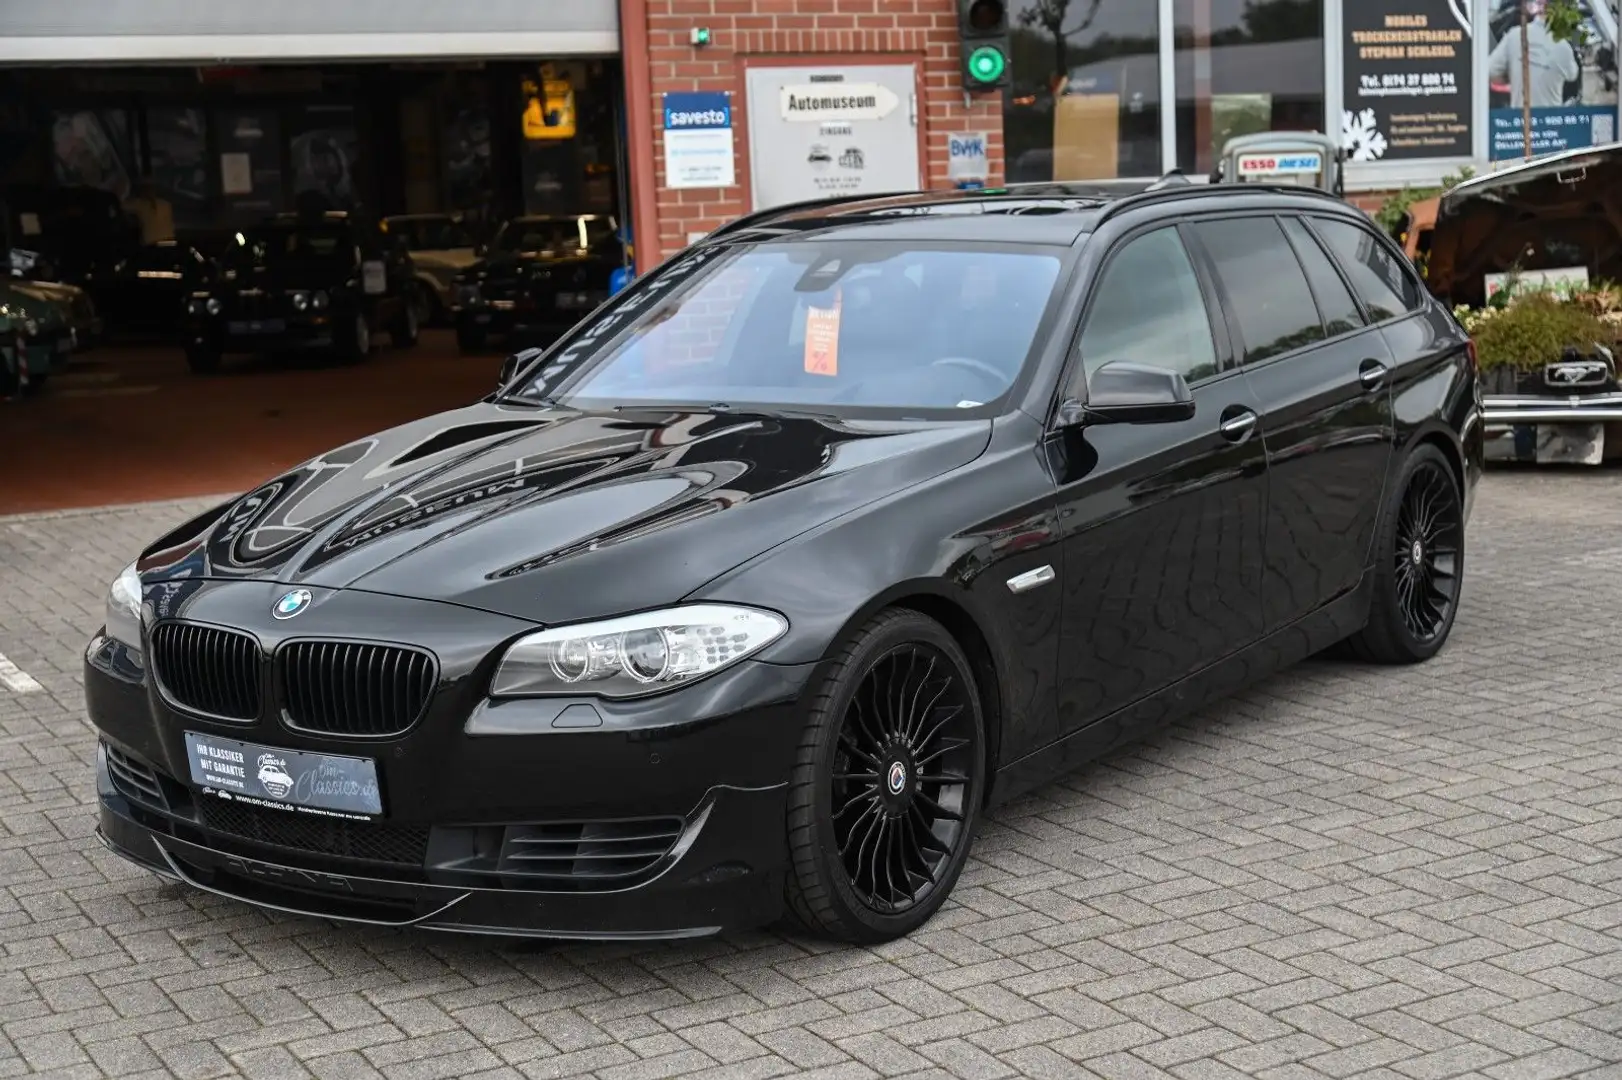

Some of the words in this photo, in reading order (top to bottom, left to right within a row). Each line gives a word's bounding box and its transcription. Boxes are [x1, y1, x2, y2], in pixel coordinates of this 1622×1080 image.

[788, 94, 876, 111] Automuseum
[1243, 158, 1276, 169] ESSO
[1278, 157, 1318, 168] DIESEL
[197, 743, 208, 756] IHR
[209, 747, 244, 763] KLASSIKER
[201, 758, 212, 770] MIT
[213, 761, 245, 778] GARANTIE
[235, 795, 294, 811] www.om-classics.de
